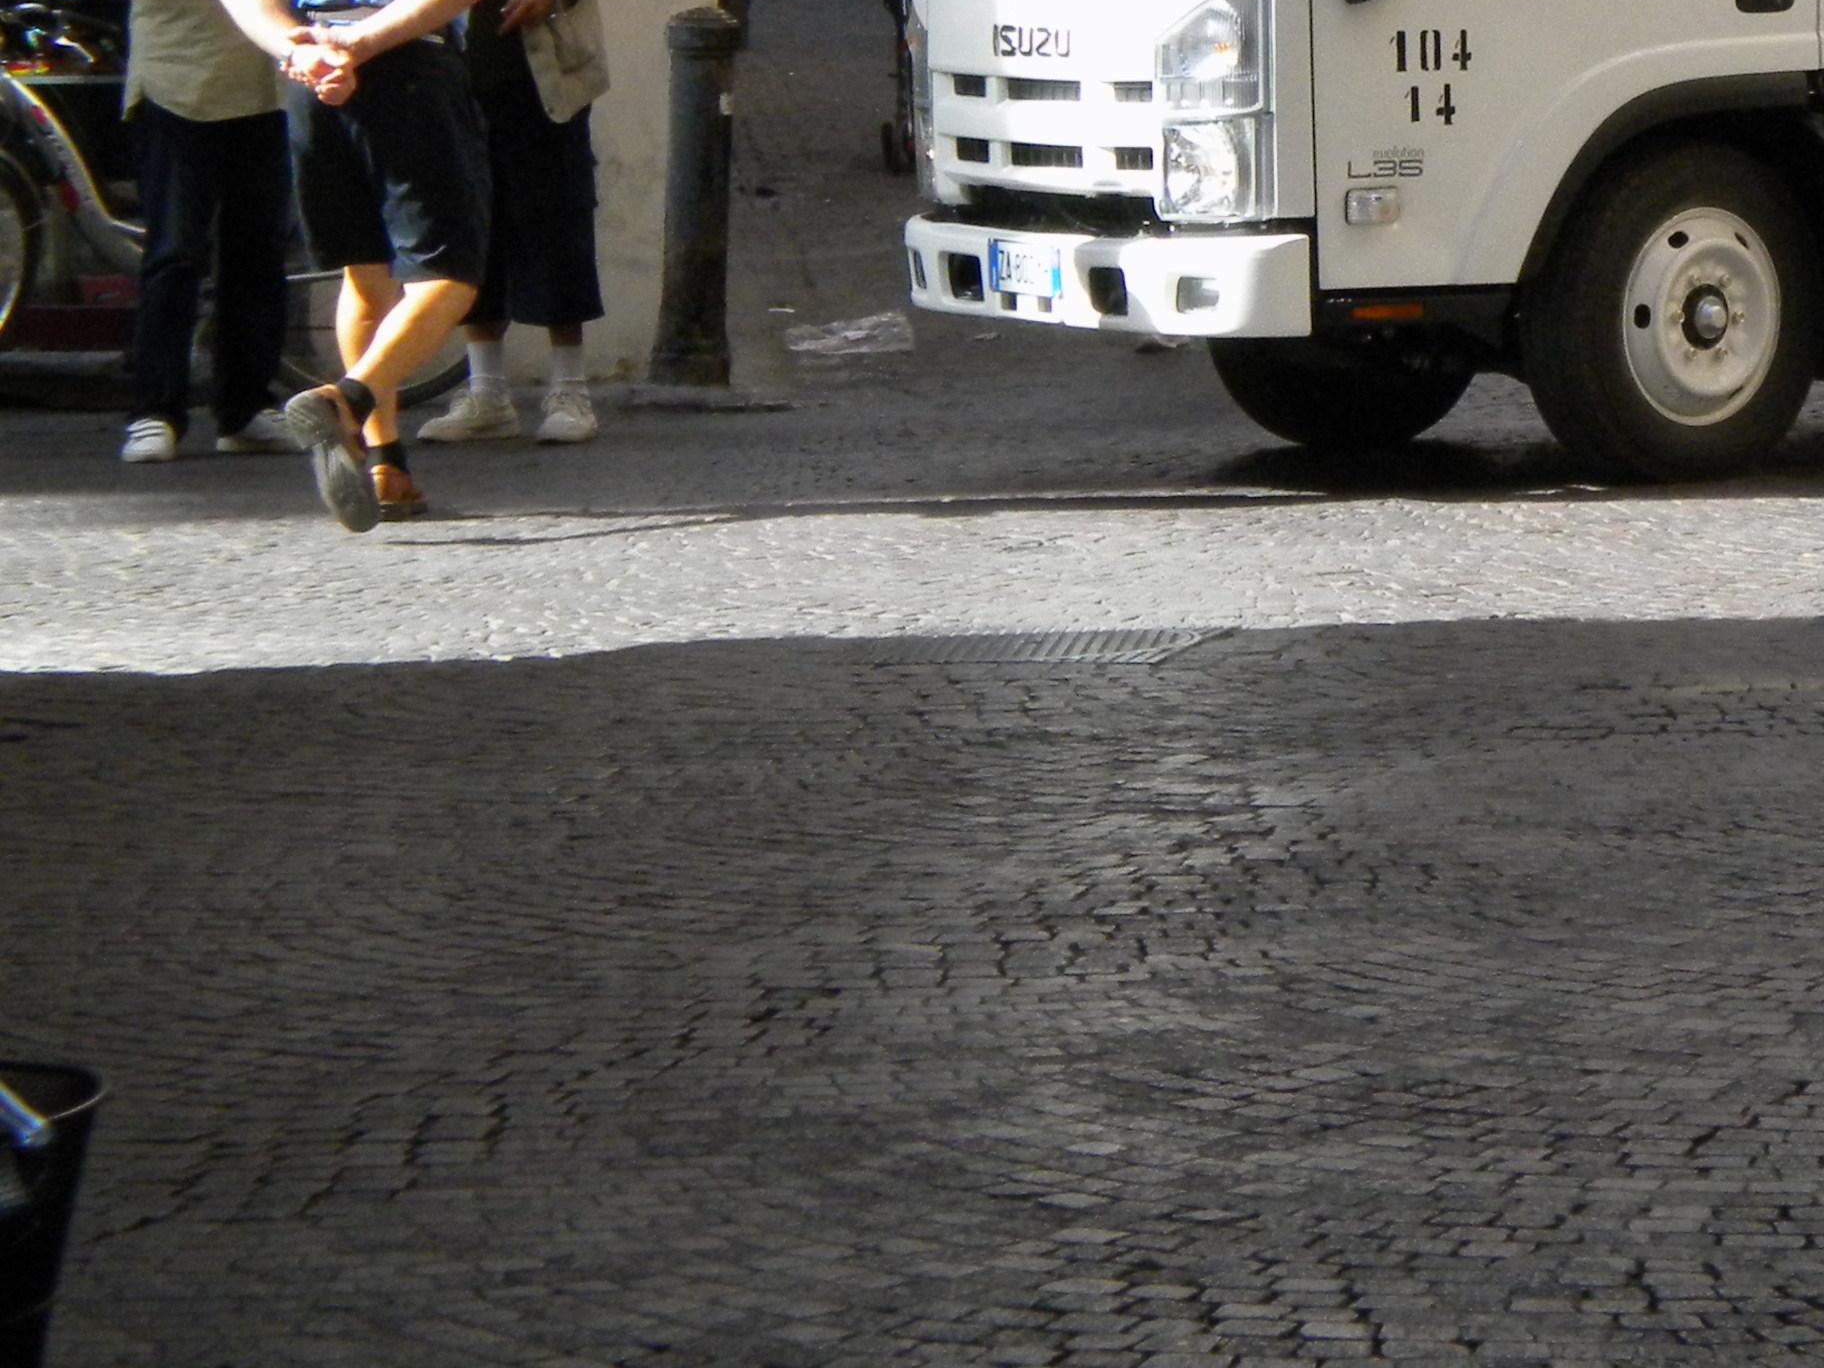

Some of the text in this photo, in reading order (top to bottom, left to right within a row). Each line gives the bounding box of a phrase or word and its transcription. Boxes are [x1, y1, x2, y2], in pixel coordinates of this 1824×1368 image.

[992, 23, 1071, 58] ISUZU
[1390, 29, 1472, 72] 104
[1405, 83, 1456, 125] 14
[1347, 158, 1424, 179] L35
